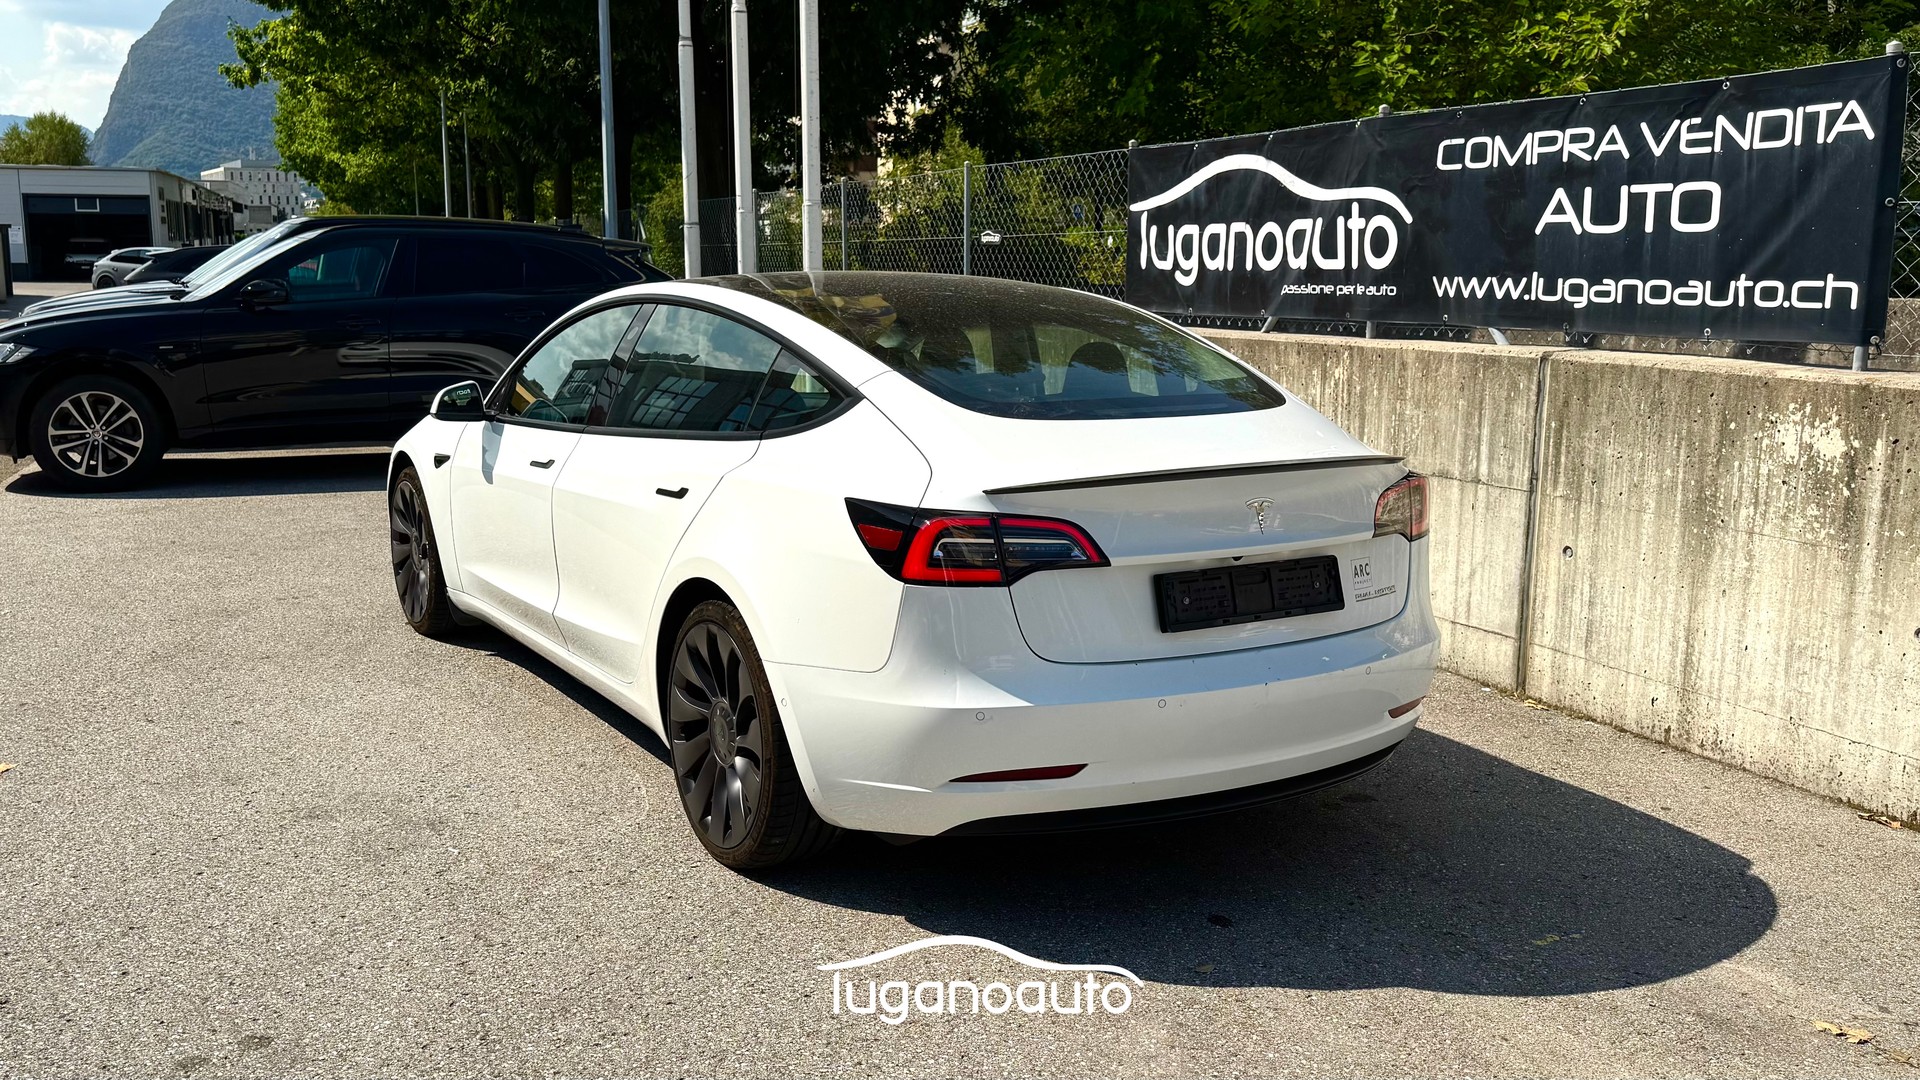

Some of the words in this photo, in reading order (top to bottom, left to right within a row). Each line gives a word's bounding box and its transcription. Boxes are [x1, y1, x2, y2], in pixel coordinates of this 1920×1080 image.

[1436, 124, 1630, 171] COMPRA
[1639, 99, 1876, 157] VENDITA
[1534, 180, 1722, 236] AUTO
[1140, 201, 1400, 287] luganoauto
[1280, 283, 1335, 296] passione
[1365, 283, 1397, 296] auto
[1432, 271, 1860, 310] www.luganoauto.ch
[1353, 562, 1370, 579] ARC
